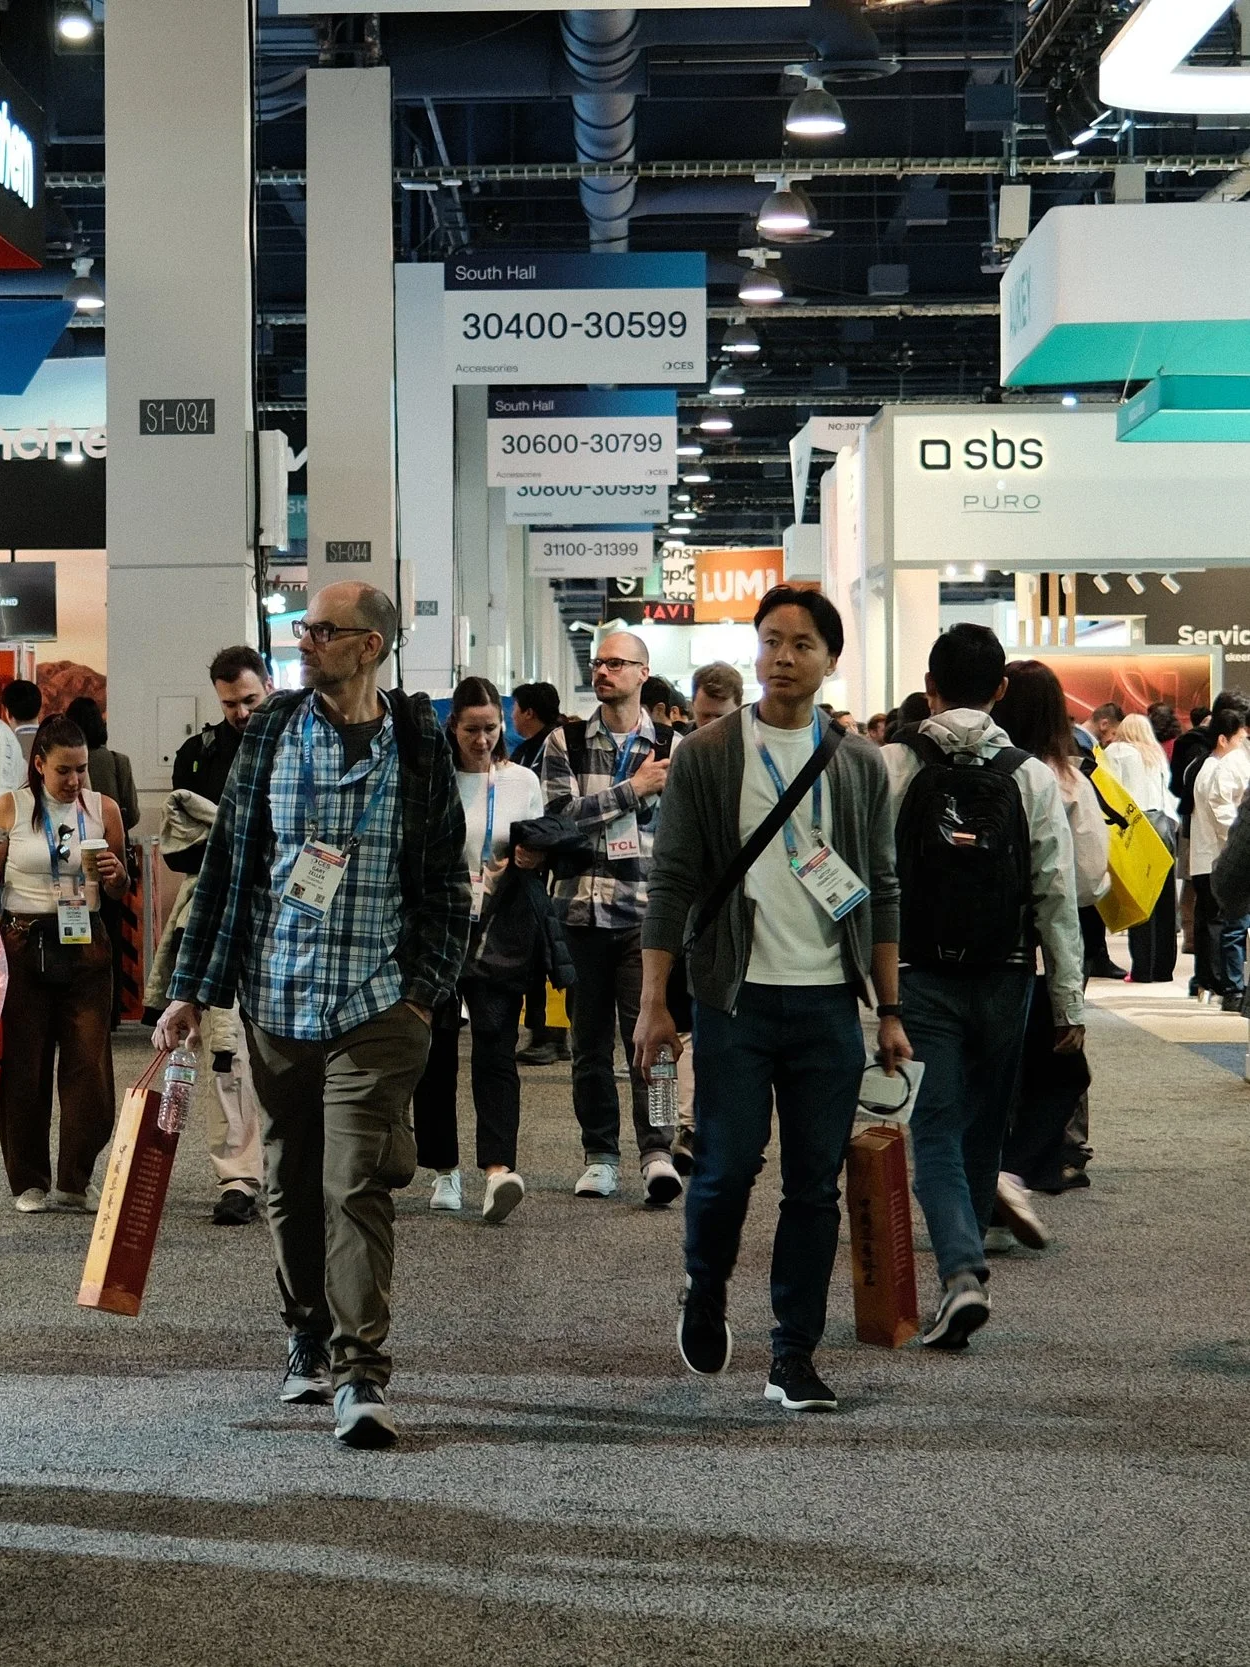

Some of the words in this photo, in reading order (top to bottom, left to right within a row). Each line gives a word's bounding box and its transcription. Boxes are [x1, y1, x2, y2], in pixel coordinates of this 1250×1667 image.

[455, 265, 501, 281] South
[507, 265, 536, 280] Hall
[462, 310, 688, 340] 30400-30599
[455, 363, 519, 374] Accessories
[672, 361, 695, 371] CES
[495, 400, 530, 412] South
[533, 400, 554, 411] Hall
[145, 402, 209, 433] S1-034
[828, 423, 864, 431] NO:307
[501, 432, 662, 455] 30600-30799
[964, 429, 1044, 470] sbs
[963, 494, 1042, 510] PURO
[329, 543, 369, 562] S1-044
[543, 542, 639, 557] 31100-31399
[1177, 624, 1250, 646] Servic
[608, 841, 638, 851] TCL
